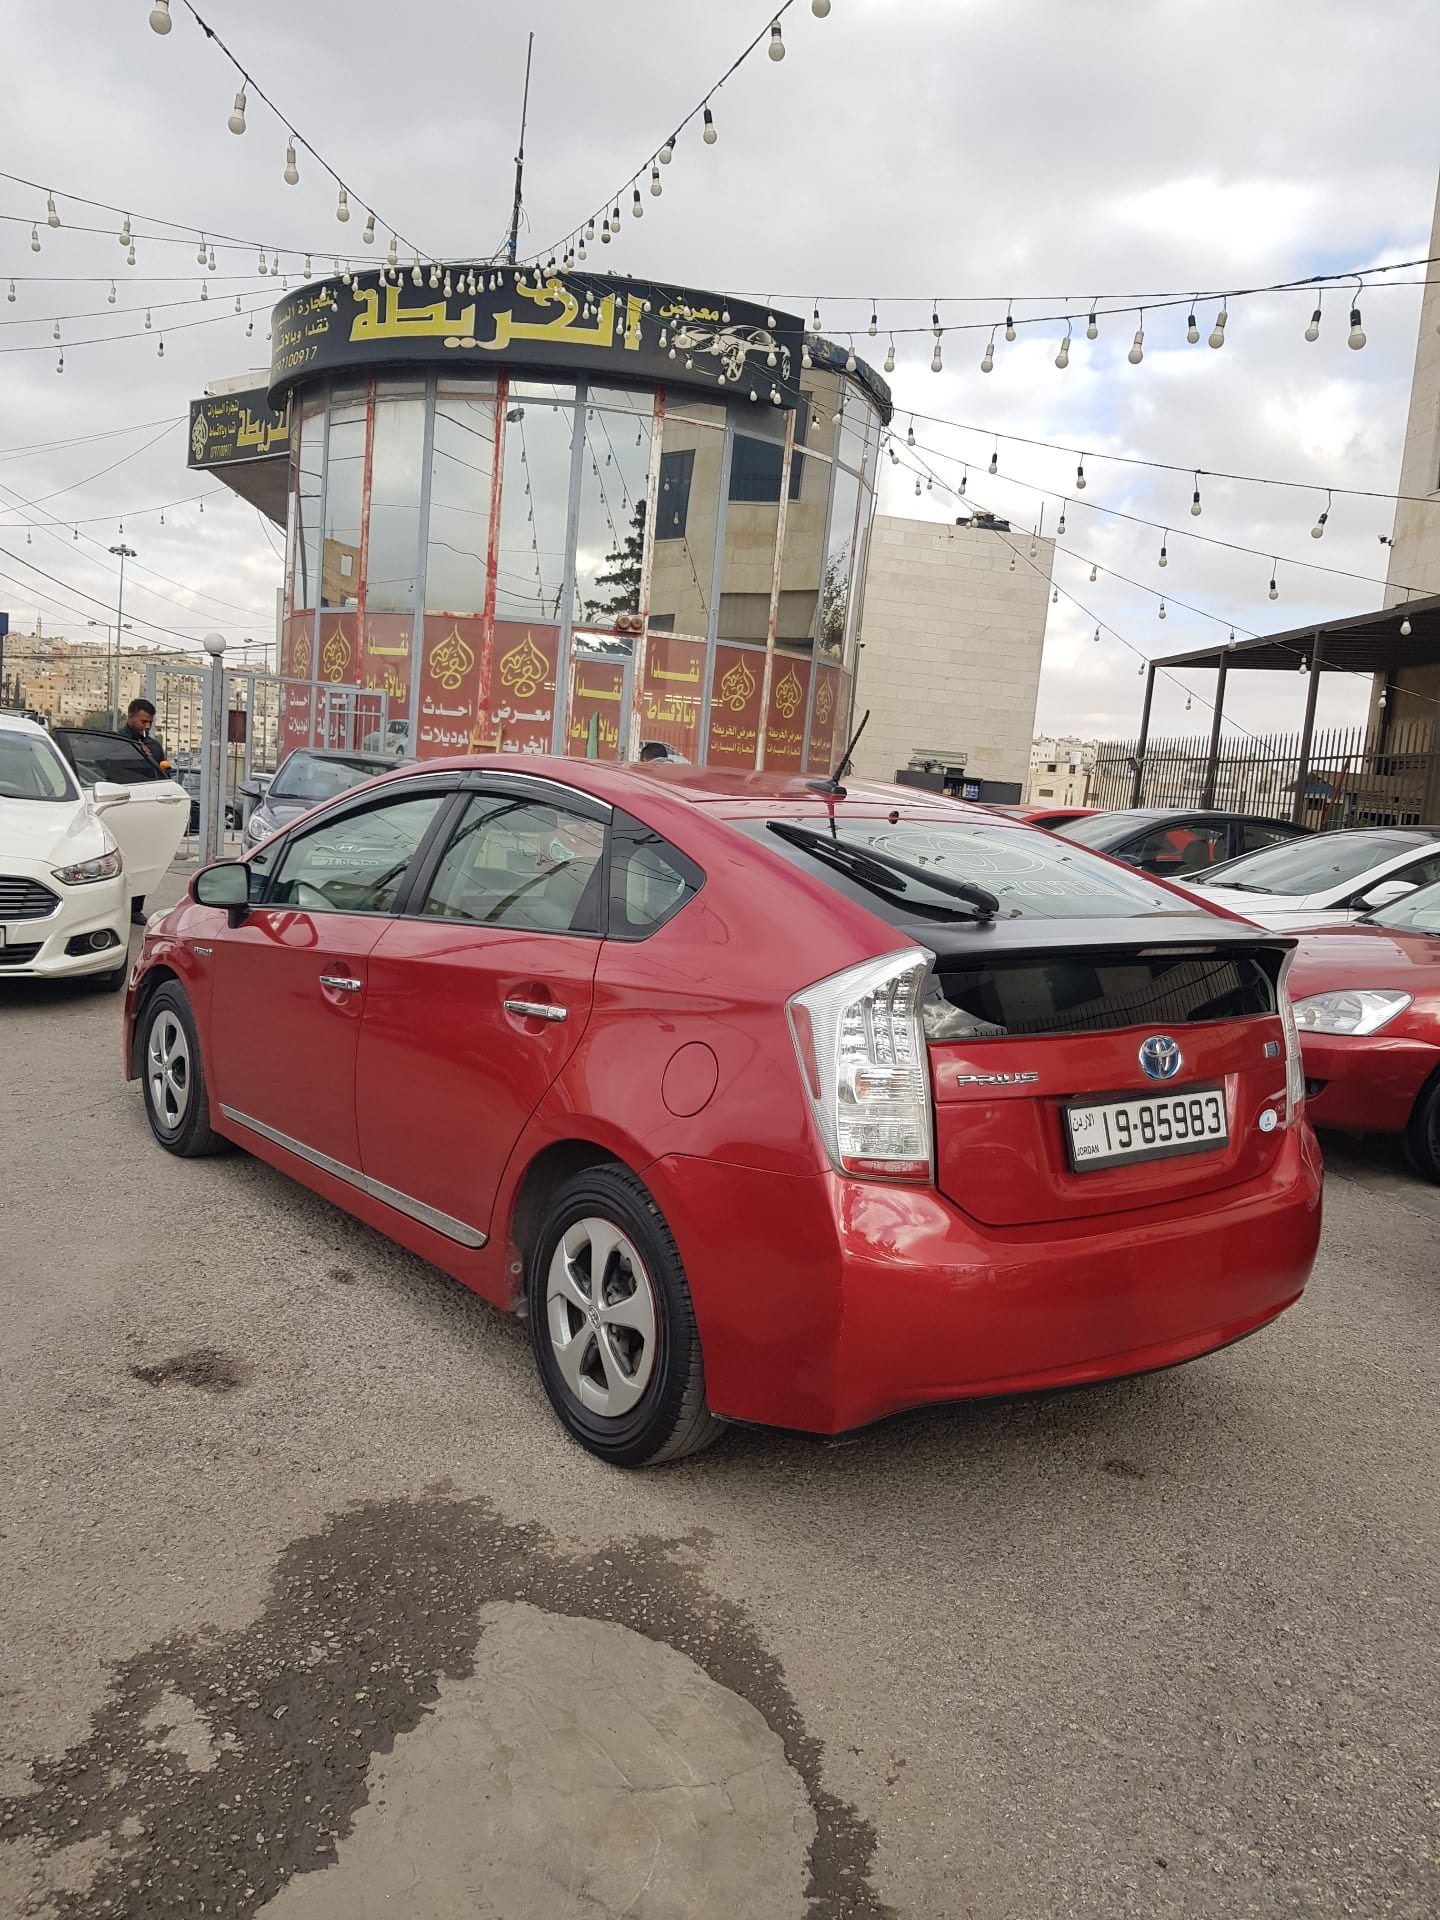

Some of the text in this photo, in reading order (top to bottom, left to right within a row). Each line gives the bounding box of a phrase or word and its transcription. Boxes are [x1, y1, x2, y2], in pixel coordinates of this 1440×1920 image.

[659, 296, 719, 322] معرض
[490, 699, 552, 724] معرض
[420, 725, 472, 747] الموديلات
[956, 1071, 1039, 1087] PRIUS
[1076, 1144, 1100, 1157] JORDAN
